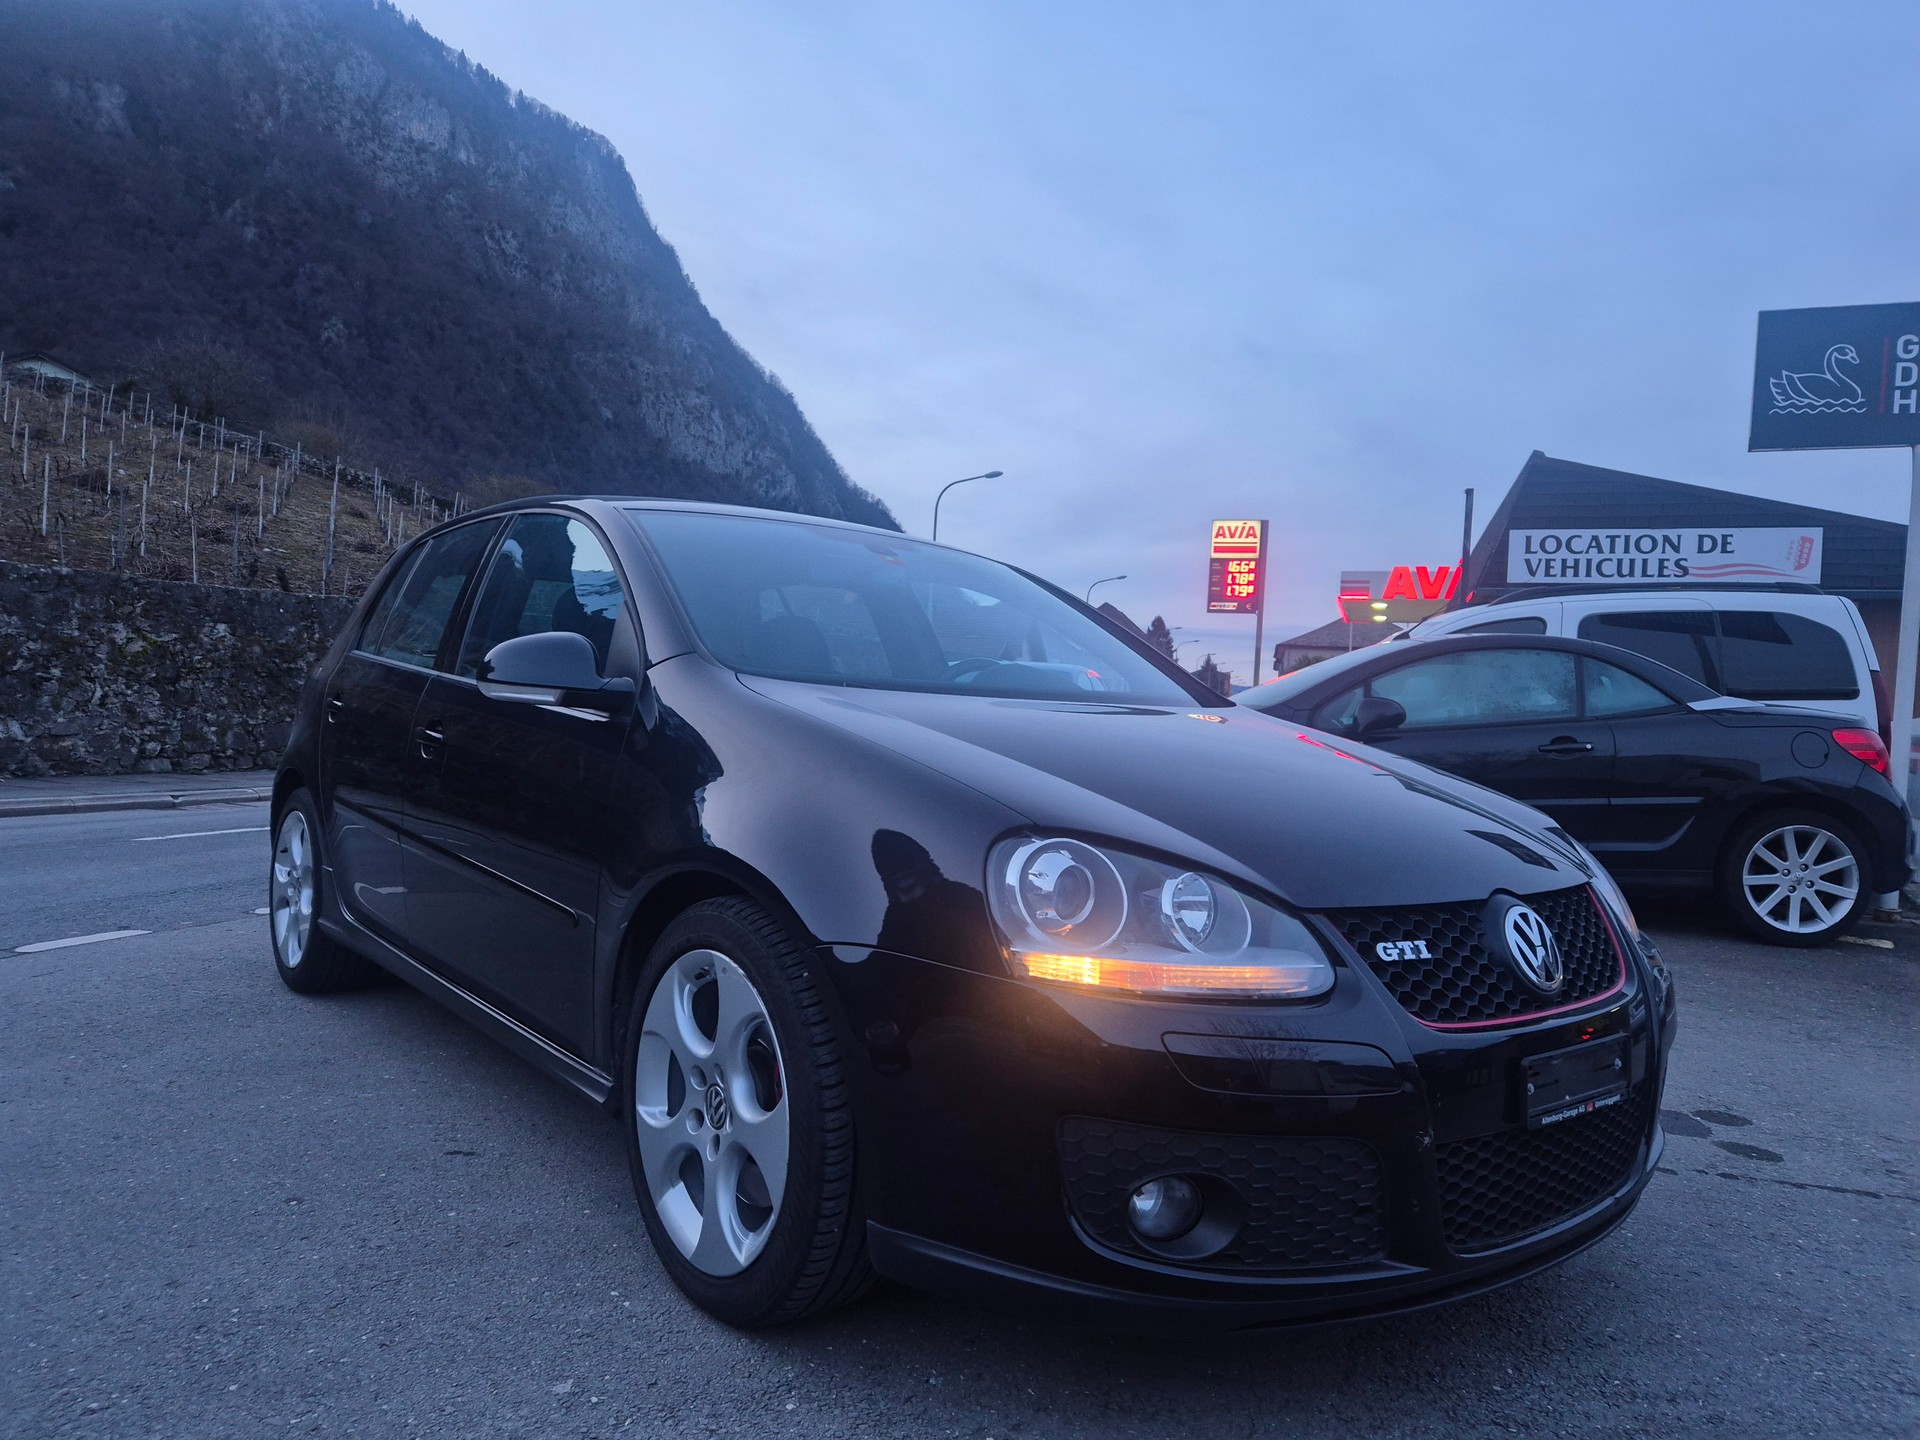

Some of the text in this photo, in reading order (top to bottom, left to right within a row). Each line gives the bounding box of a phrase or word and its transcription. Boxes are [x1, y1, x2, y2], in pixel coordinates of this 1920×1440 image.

[1896, 334, 1920, 360] G
[1895, 361, 1919, 387] D
[1524, 533, 1736, 555] LOCATION DE
[1382, 558, 1475, 600] AVI
[1524, 557, 1690, 579] VEHICULES
[1375, 940, 1432, 962] GTI
